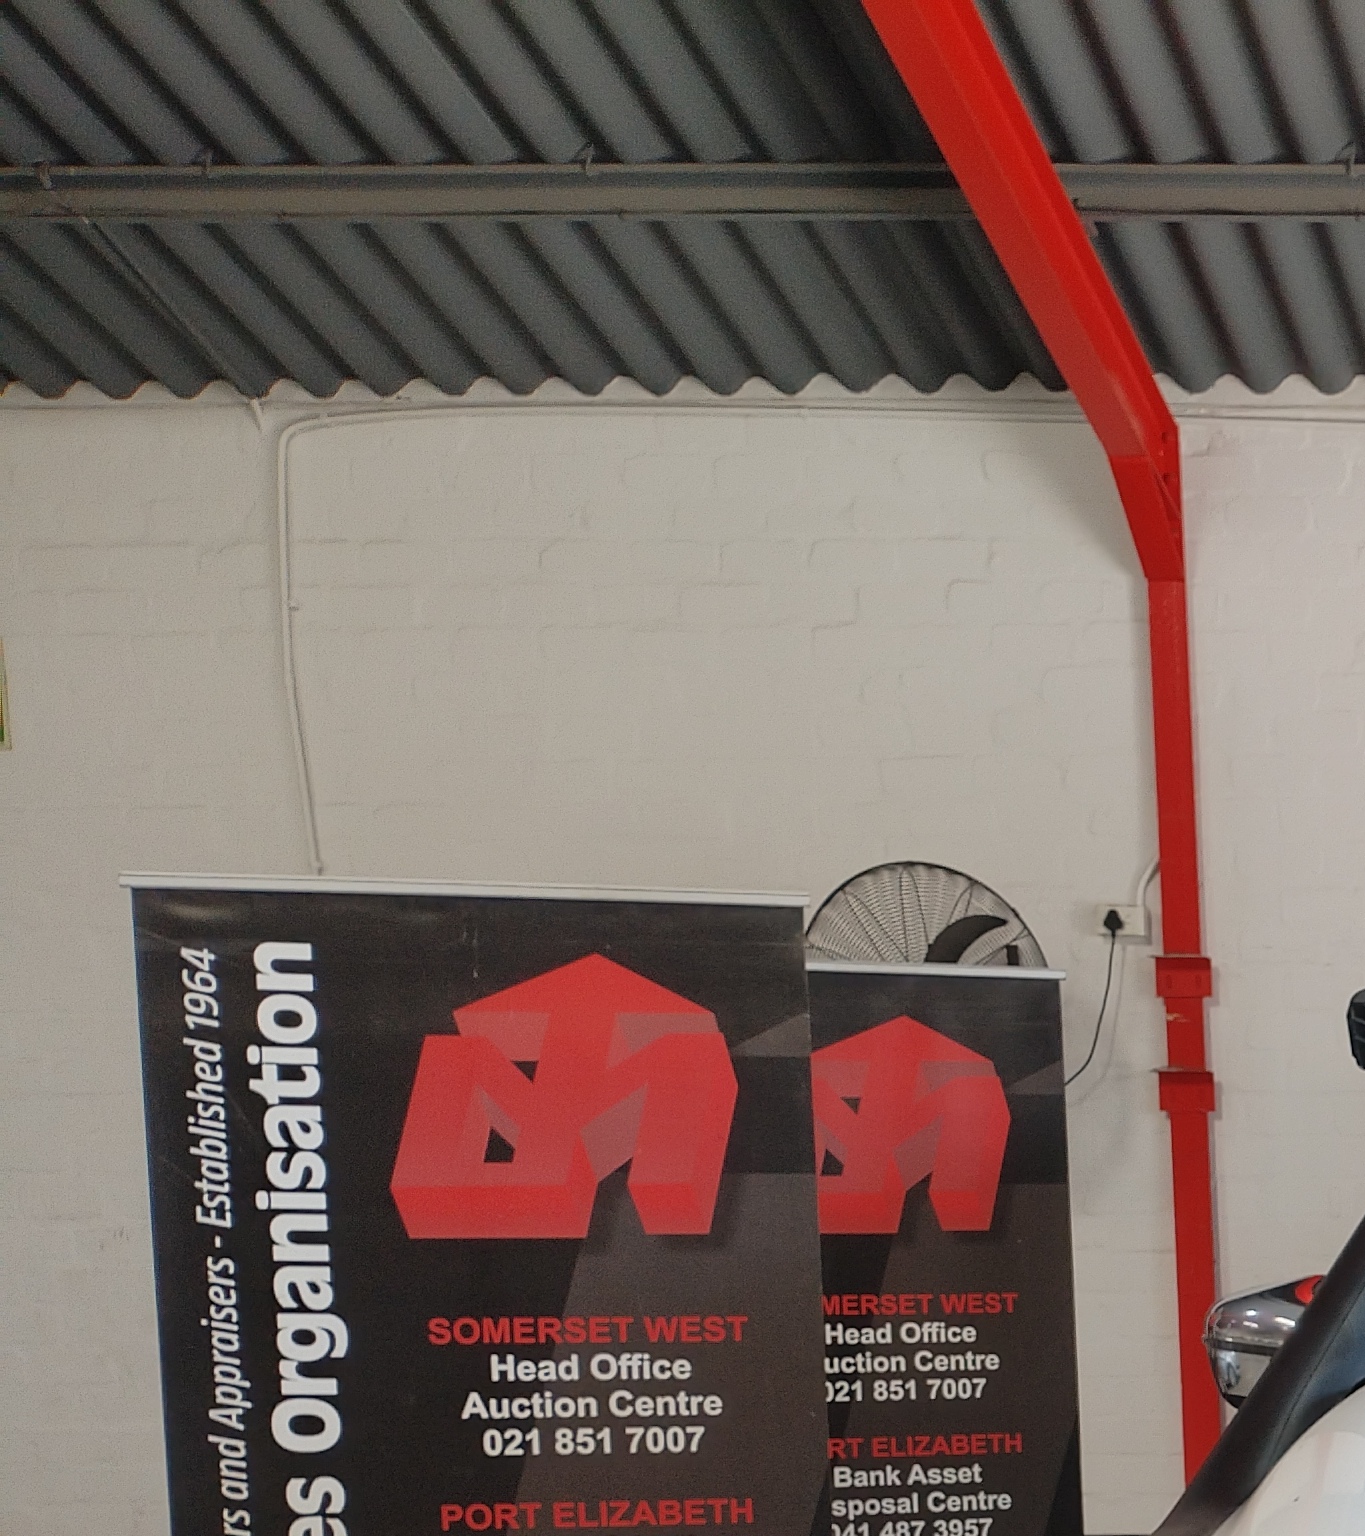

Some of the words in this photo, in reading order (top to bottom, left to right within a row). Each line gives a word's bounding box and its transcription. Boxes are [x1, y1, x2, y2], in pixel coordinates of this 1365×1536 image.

[180, 946, 220, 1030] 1964
[182, 1036, 233, 1229] Established
[246, 940, 350, 1454] Organisation
[821, 1294, 933, 1316] MERSET
[939, 1291, 1019, 1315] WEST
[200, 1255, 253, 1432] Appraisers
[427, 1315, 634, 1346] SOMERSET
[643, 1314, 749, 1343] WEST
[825, 1322, 892, 1346] Head
[899, 1321, 977, 1344] Office
[490, 1353, 580, 1382] Head
[589, 1352, 693, 1381] Office
[824, 1352, 906, 1374] uction
[913, 1349, 1001, 1372] Centre
[461, 1390, 599, 1420] Auction
[608, 1389, 723, 1418] Centre
[872, 1378, 917, 1402] 851
[926, 1377, 987, 1400] 7007
[482, 1427, 541, 1457] 021
[554, 1426, 612, 1456] 851
[624, 1425, 706, 1454] 7007
[827, 1437, 864, 1459] RT
[870, 1432, 1023, 1459] ELIZABETH
[207, 1434, 249, 1501] and
[833, 1464, 902, 1489] Bank
[906, 1462, 983, 1486] Asset
[440, 1501, 543, 1531] PORT
[552, 1497, 754, 1529] ELIZABETH
[831, 1493, 919, 1520] sposal
[926, 1490, 1013, 1513] Centre
